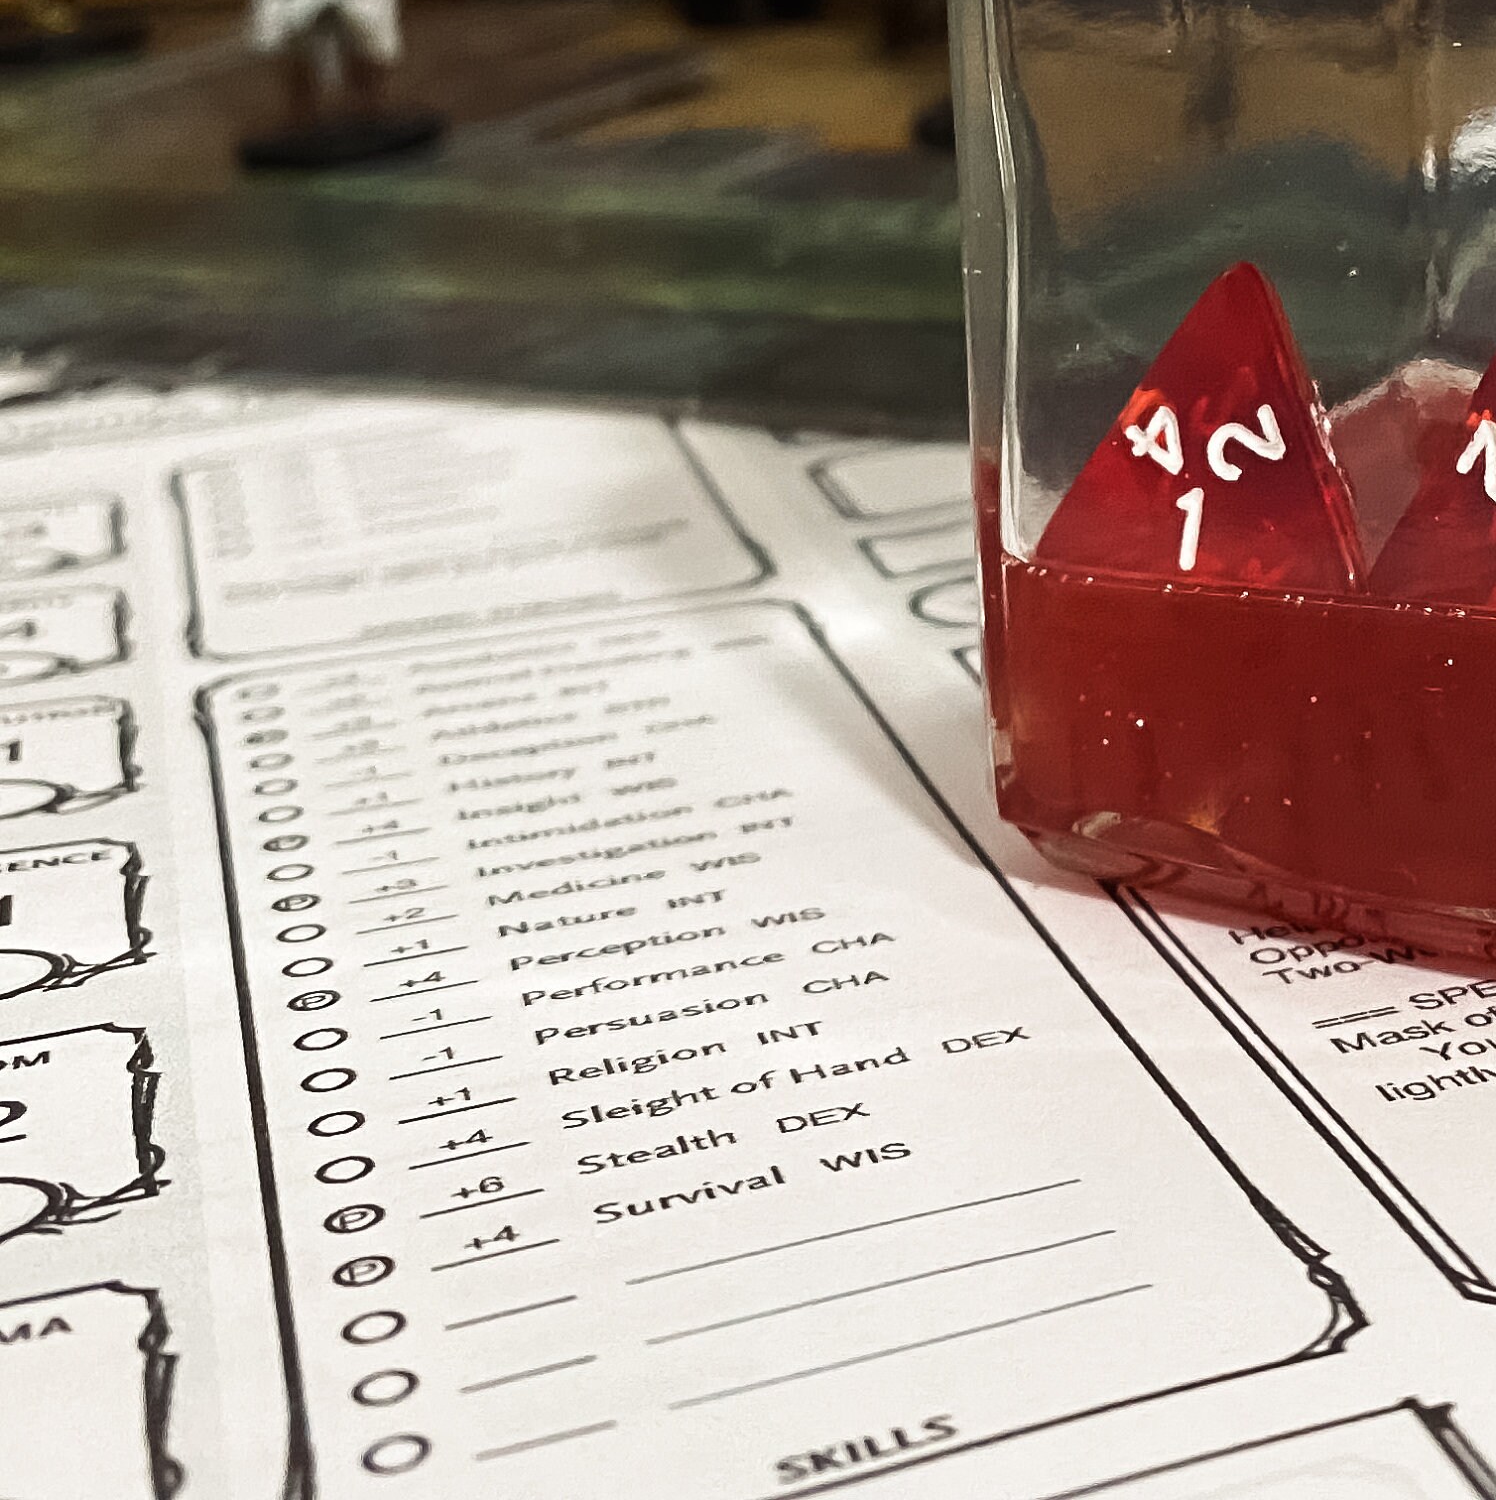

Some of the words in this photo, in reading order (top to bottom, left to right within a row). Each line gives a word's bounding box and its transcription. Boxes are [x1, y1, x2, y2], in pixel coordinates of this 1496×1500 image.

[1207, 404, 1286, 481] 2
[1176, 487, 1204, 571] 1
[467, 805, 694, 850] Intimidation
[713, 788, 793, 808] CHA
[477, 831, 718, 877] Investigation
[740, 816, 794, 834] INT
[383, 907, 426, 923] +2
[487, 869, 667, 905] Medicine
[690, 852, 762, 871] WIS
[499, 905, 637, 937] Nature
[667, 888, 727, 909] INT
[399, 971, 446, 988] +4
[509, 926, 727, 972] Perception
[750, 907, 826, 928] WIS
[521, 950, 786, 1007] Performance
[811, 931, 897, 954] CHA
[534, 990, 769, 1046] Persuasion
[802, 970, 890, 994] CHA
[1330, 1019, 1456, 1054] Mask
[428, 1086, 471, 1106] +1
[548, 1040, 727, 1086] Religion
[757, 1021, 825, 1046] INT
[439, 1129, 494, 1150] +4
[561, 1084, 721, 1130] Sleight
[730, 1070, 776, 1096] of
[789, 1046, 912, 1085] Hand
[941, 1025, 1032, 1055] DEX
[450, 1176, 505, 1199] +6
[577, 1128, 738, 1176] Stealth
[776, 1102, 871, 1134] DEX
[464, 1224, 521, 1250] +4
[593, 1164, 787, 1224] Survival
[819, 1141, 913, 1173] WIS
[775, 1413, 960, 1485] SKILLS
